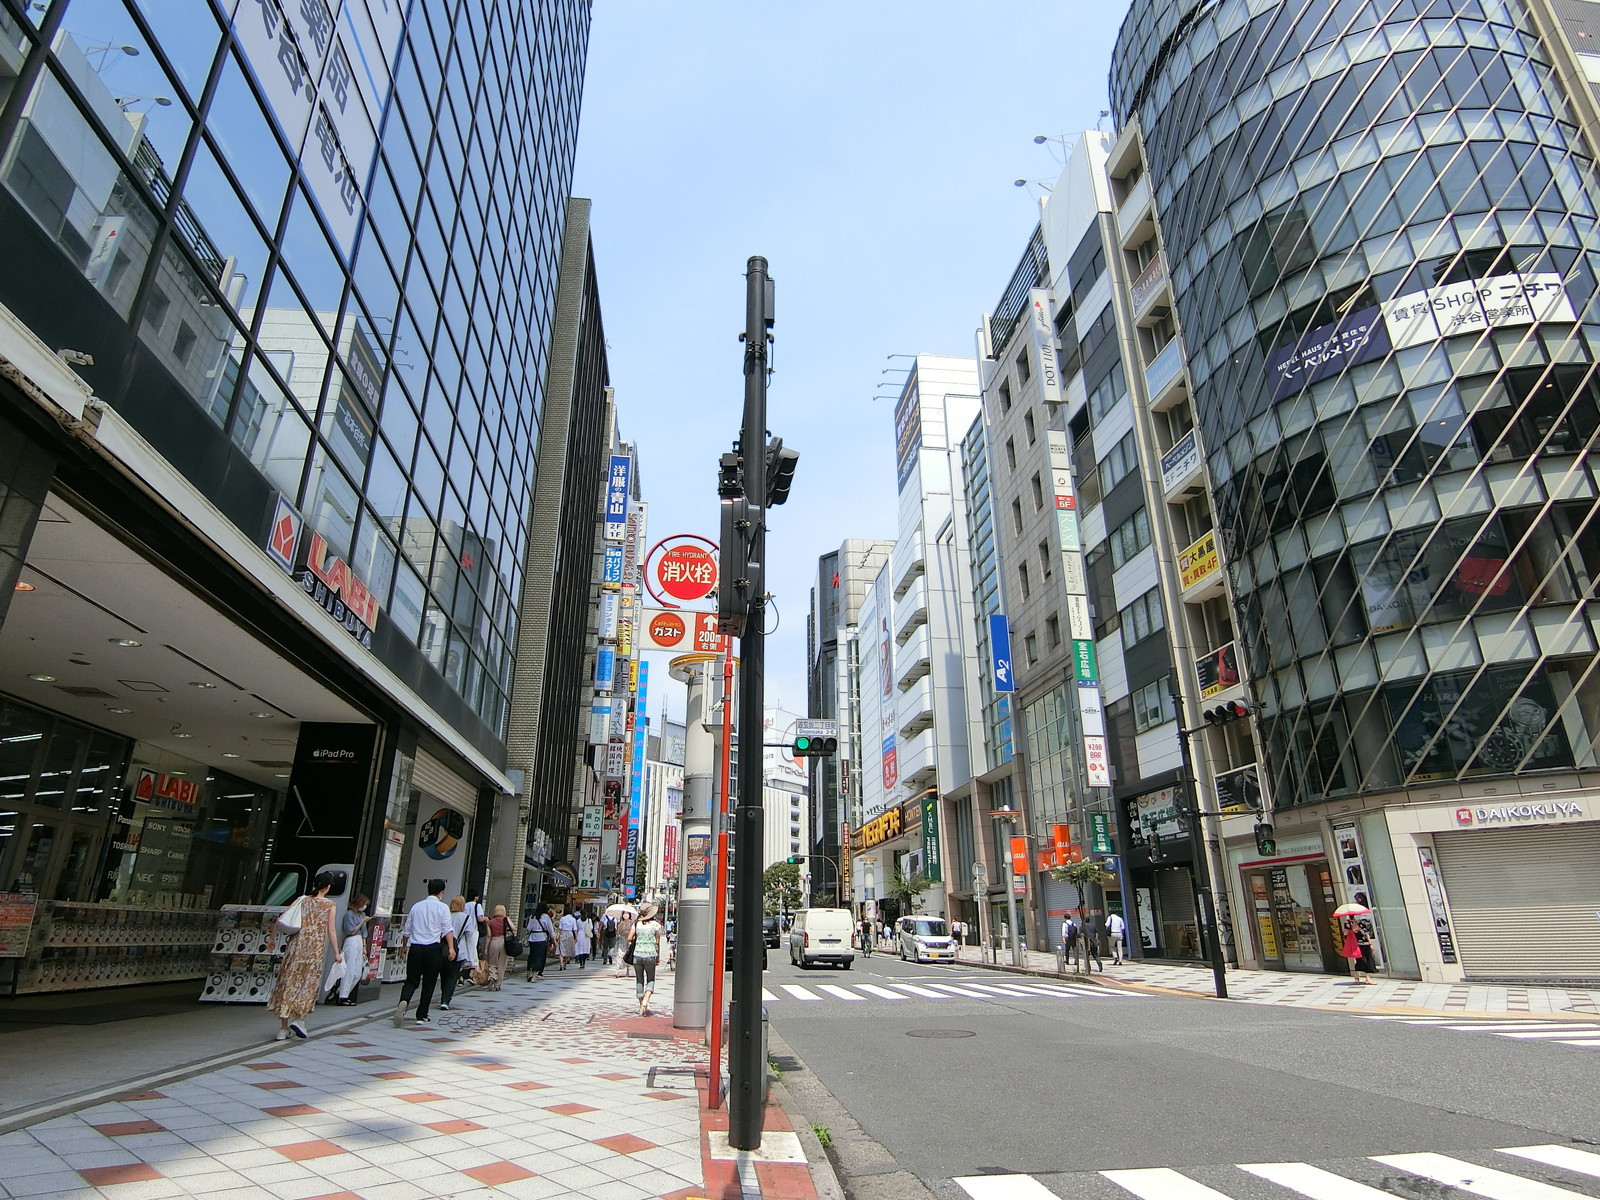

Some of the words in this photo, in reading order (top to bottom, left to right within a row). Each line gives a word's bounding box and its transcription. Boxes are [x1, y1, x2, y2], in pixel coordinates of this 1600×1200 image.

[1432, 288, 1493, 312] SHOP
[1044, 363, 1056, 387] DOT
[1176, 453, 1197, 478] ニチワ
[610, 465, 627, 515] 洋服の青山
[1433, 530, 1497, 552] DAKOKUYA
[668, 551, 680, 559] FIRE
[682, 551, 708, 560] HYDRANT
[612, 557, 621, 581] パソコン
[662, 560, 713, 585] 消火栓
[307, 529, 379, 633] LABI
[302, 570, 372, 650] SHIBUYA
[653, 627, 682, 638] ガスト
[698, 631, 721, 643] 200m
[997, 659, 1010, 683] A2
[1078, 641, 1091, 678] 宝石広場
[1423, 692, 1468, 702] HARR
[320, 749, 339, 759] iPad
[340, 749, 354, 759] Pro
[157, 774, 199, 804] LABI
[1475, 801, 1583, 820] DAIKOKUYA
[147, 821, 167, 833] SONY
[112, 841, 137, 853] TOSHIBA
[140, 846, 162, 856] SHARP
[625, 829, 637, 885] クロサワ楽器店
[136, 872, 154, 883] NEC
[580, 879, 595, 887] B1
